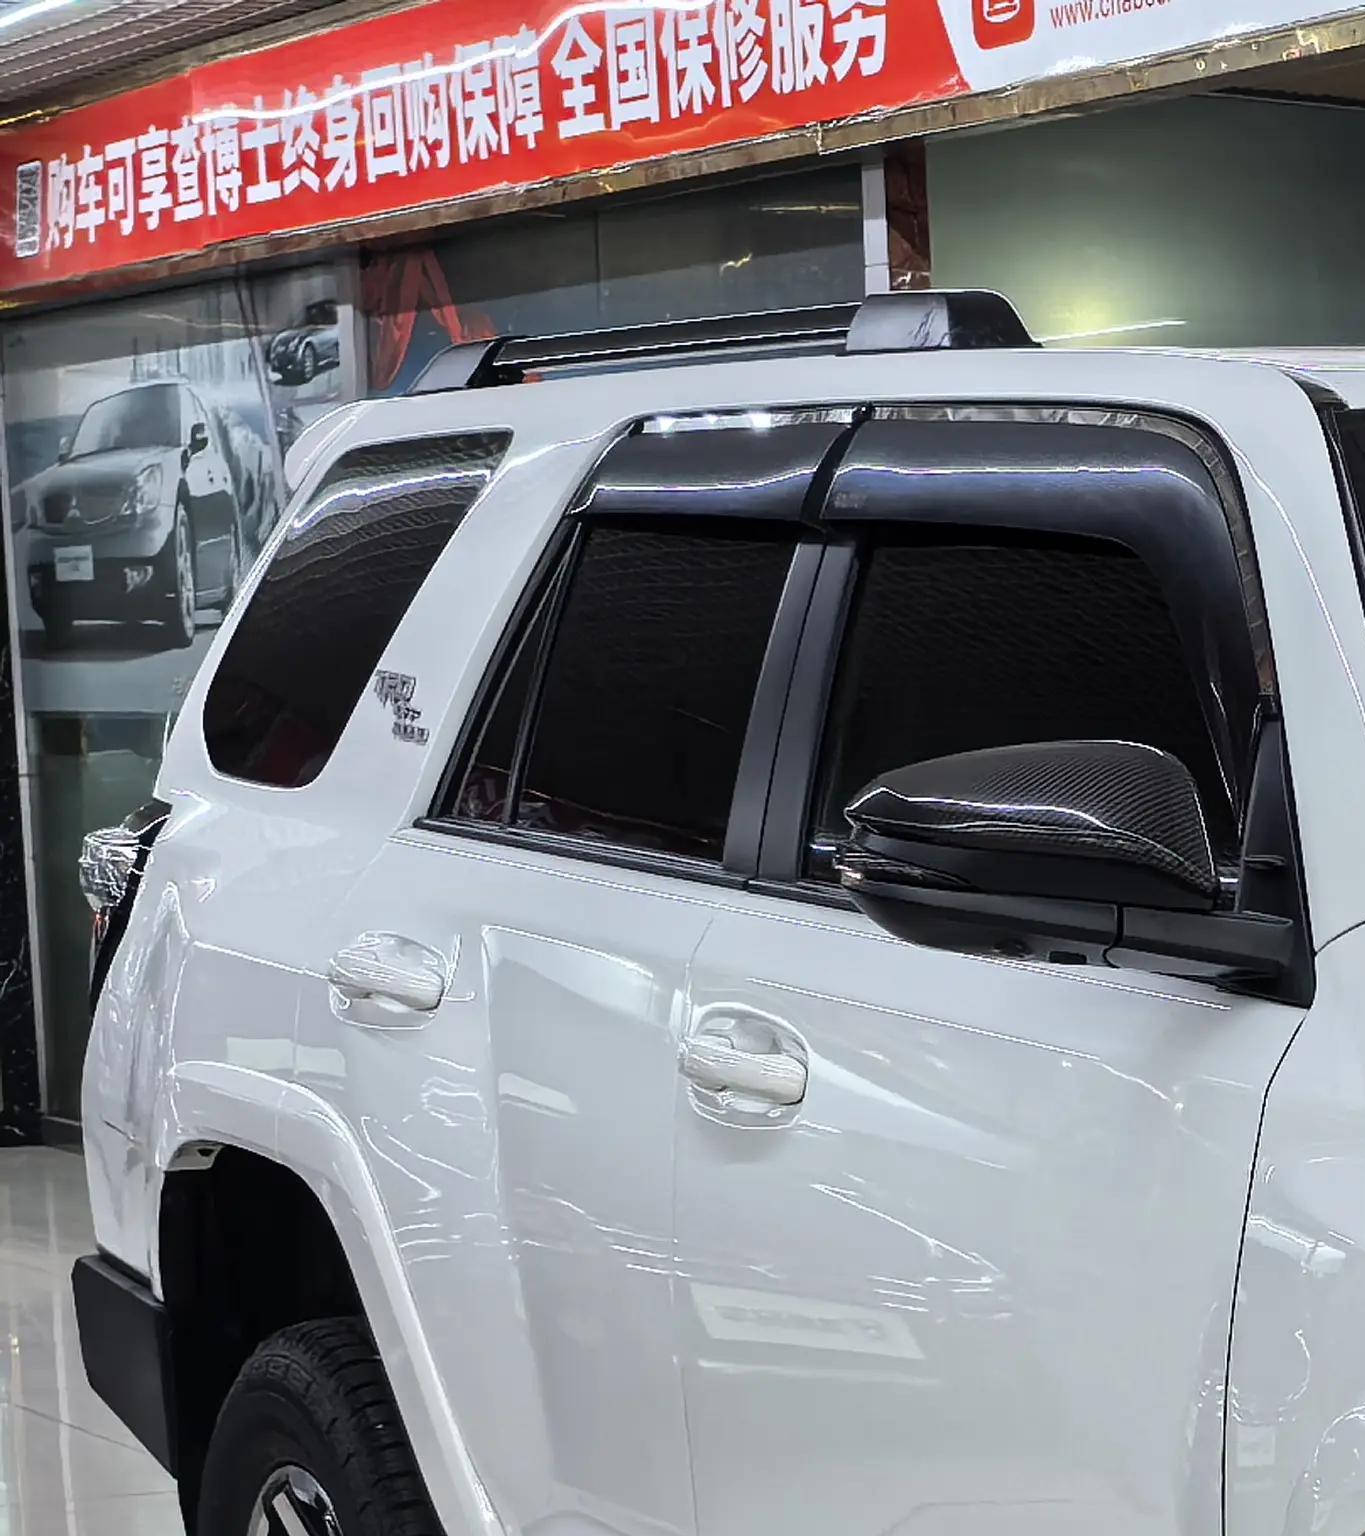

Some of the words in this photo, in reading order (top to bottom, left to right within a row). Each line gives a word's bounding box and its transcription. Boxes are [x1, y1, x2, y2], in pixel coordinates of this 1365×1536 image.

[45, 25, 545, 250] 购车可享查博士终身回购保障
[551, 0, 886, 140] 全国保修服务
